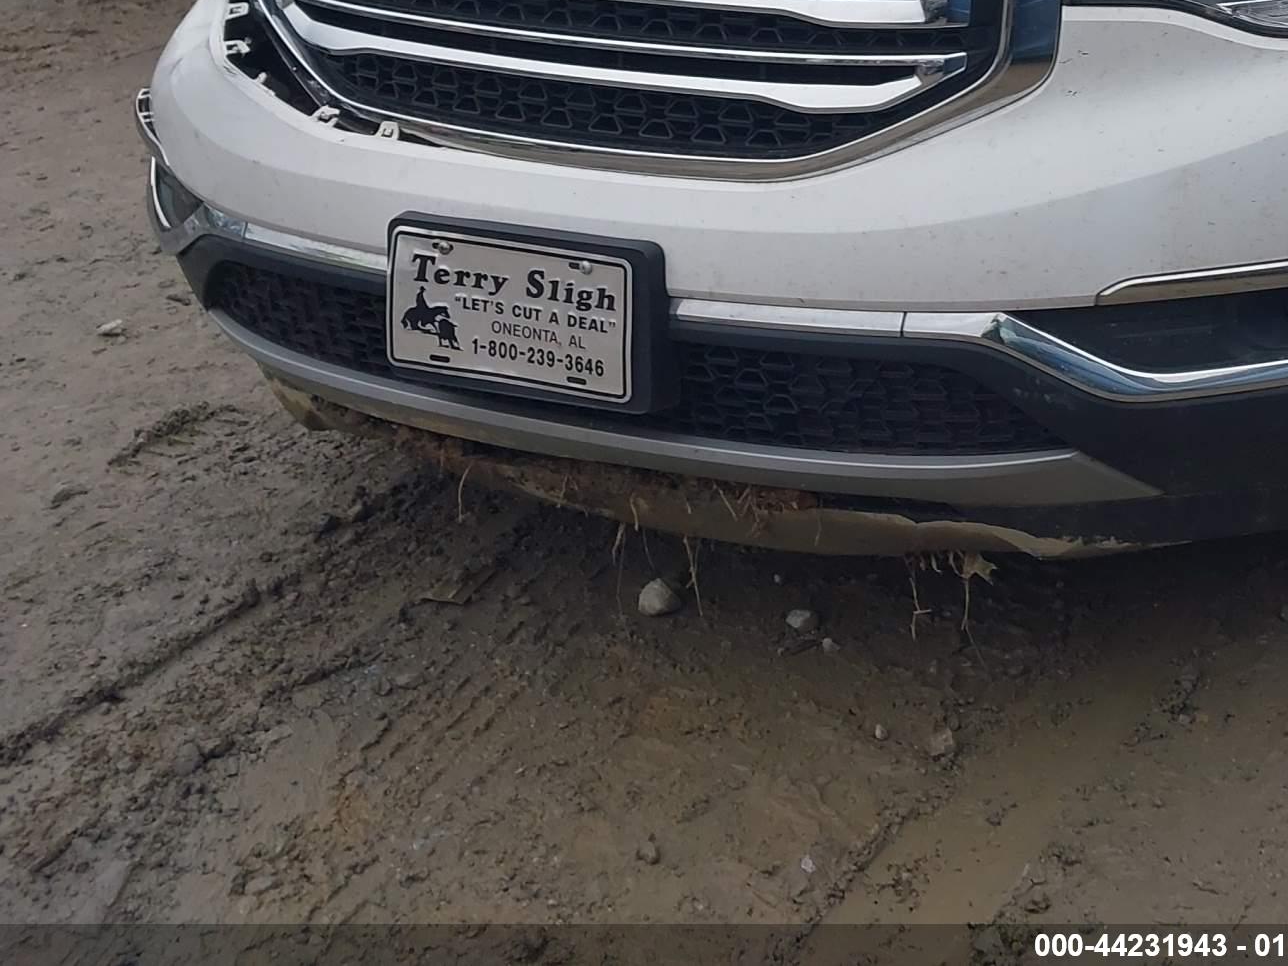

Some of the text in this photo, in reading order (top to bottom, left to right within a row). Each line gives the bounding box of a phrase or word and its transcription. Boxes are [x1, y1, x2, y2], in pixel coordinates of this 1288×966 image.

[412, 253, 616, 312] Terry Sligh
[455, 295, 504, 315] "LET'S
[512, 304, 543, 322] CUT
[549, 312, 560, 326] A
[491, 320, 586, 350] ONEONTA, AL
[471, 338, 605, 377] 1-800-239-3646
